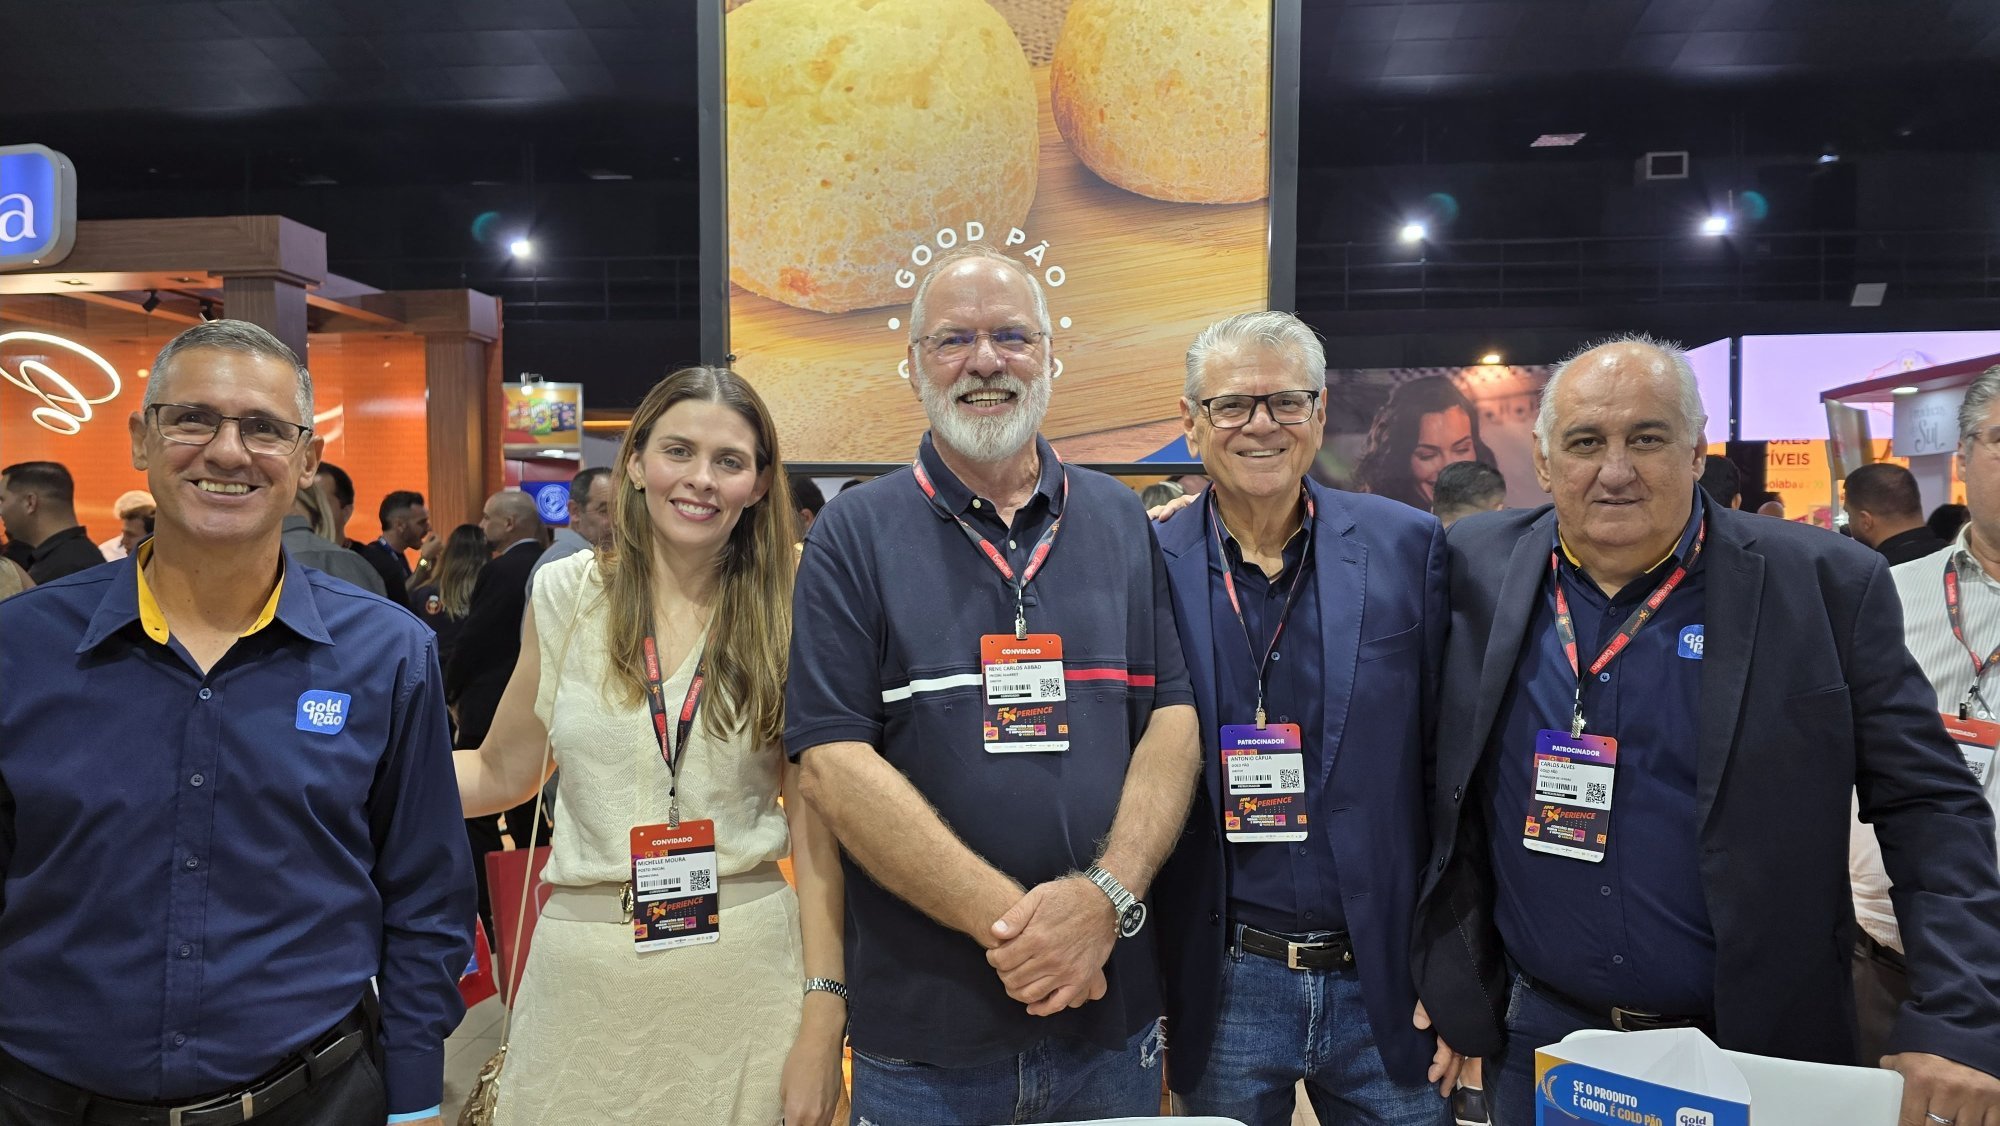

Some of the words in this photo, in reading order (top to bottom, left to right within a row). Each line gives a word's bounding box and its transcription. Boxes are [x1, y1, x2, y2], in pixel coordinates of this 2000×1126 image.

[895, 222, 985, 289] GOOD
[1005, 227, 1066, 287] PÃO
[302, 698, 342, 720] Gold
[313, 712, 342, 726] Pão
[1237, 738, 1285, 746] PATROCINADOR
[1552, 745, 1600, 757] PATROCINADOR
[652, 836, 693, 846] CONVIDADO
[638, 858, 664, 867] MICHELLE
[665, 856, 687, 864] MOURA
[1573, 1080, 1584, 1093] SE
[1585, 1083, 1593, 1095] O
[1594, 1086, 1638, 1108] PRODUTO
[1573, 1092, 1579, 1107] É
[1610, 1103, 1616, 1117] É
[1617, 1107, 1643, 1124] GOLD
[1644, 1113, 1663, 1126] PÃO
[1680, 1114, 1707, 1125] Gold
